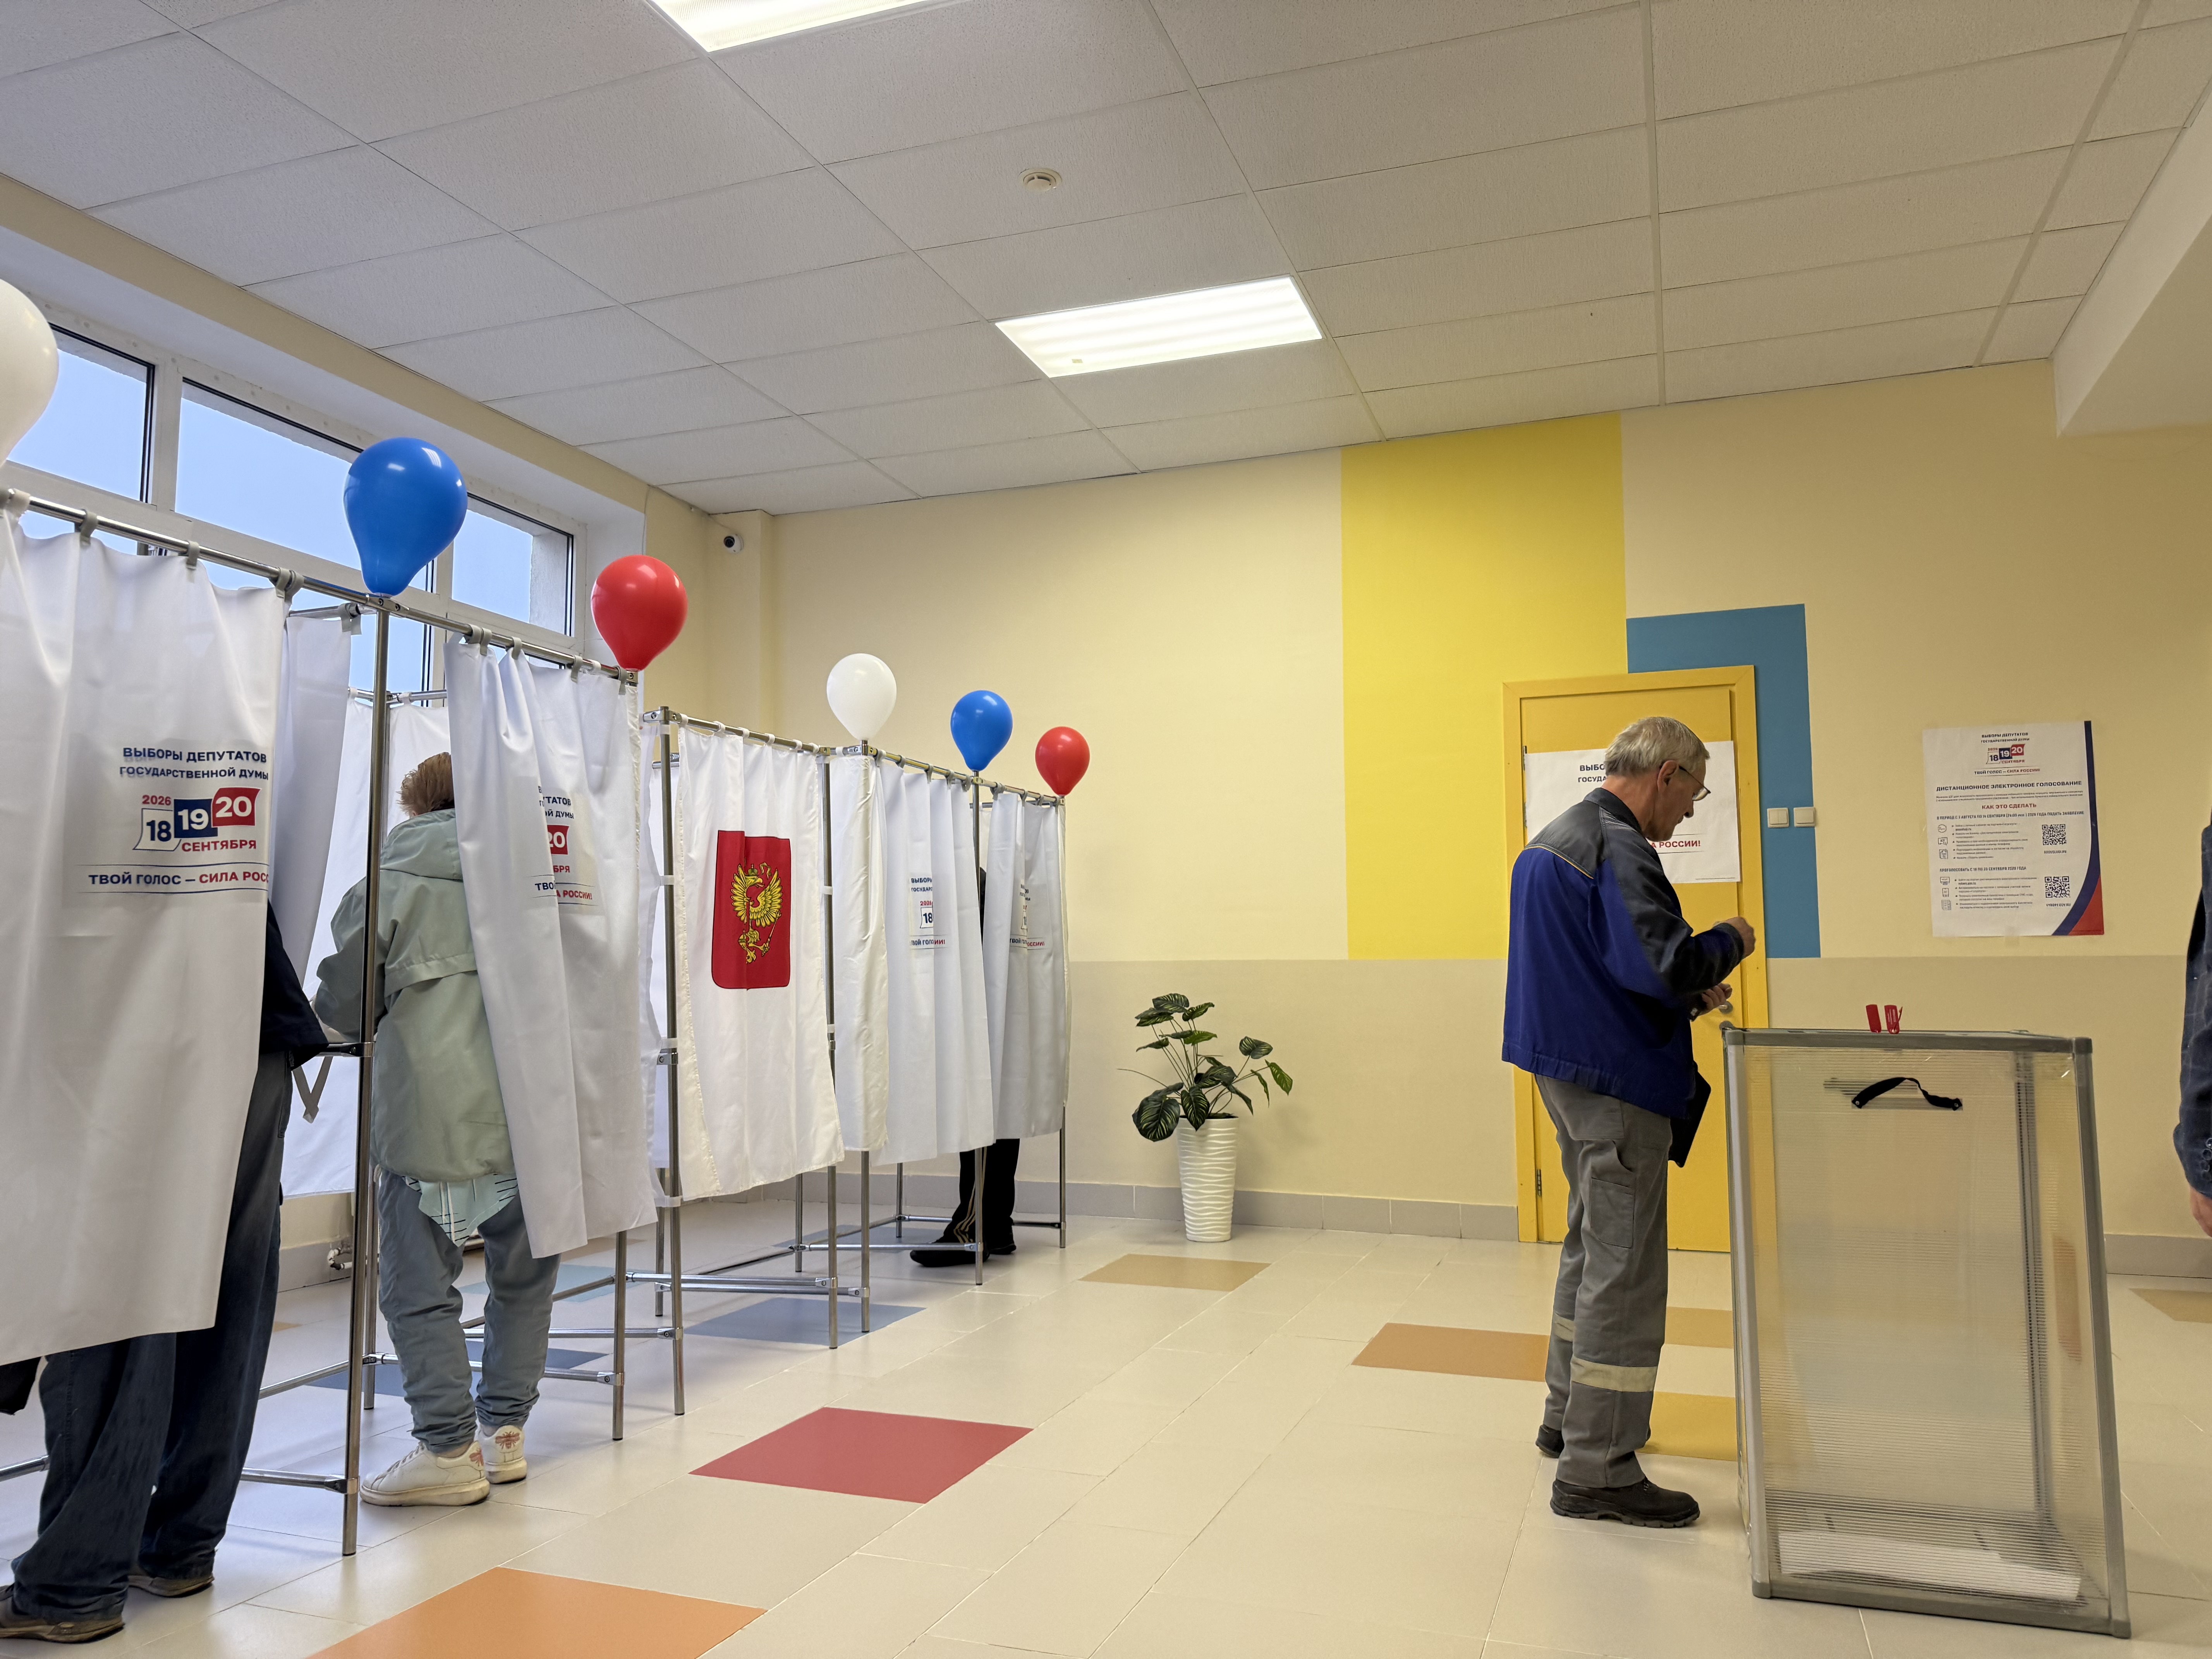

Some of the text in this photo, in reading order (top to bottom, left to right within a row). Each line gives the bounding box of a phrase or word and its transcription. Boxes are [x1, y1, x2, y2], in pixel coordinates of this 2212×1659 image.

[123, 747, 267, 763] ВЫБОРЫ ДЕПУТАТОВ
[120, 766, 269, 780] ГОСУДАРСТВЕННОЙ ДУМЫ
[142, 795, 172, 805] 2026
[543, 797, 571, 806] ТАТОВ
[146, 796, 252, 842] 18 19 20
[555, 811, 574, 819] ДУМЫ
[182, 840, 256, 852] СЕНТЯБРЯ
[89, 872, 132, 884] ТВОЙ
[136, 874, 181, 885] ГОЛОС
[199, 872, 239, 883] СИЛА
[243, 871, 269, 883] РОСС
[534, 881, 556, 891] ТВО
[563, 890, 592, 900] РОССИИ!
[923, 913, 933, 923] 18
